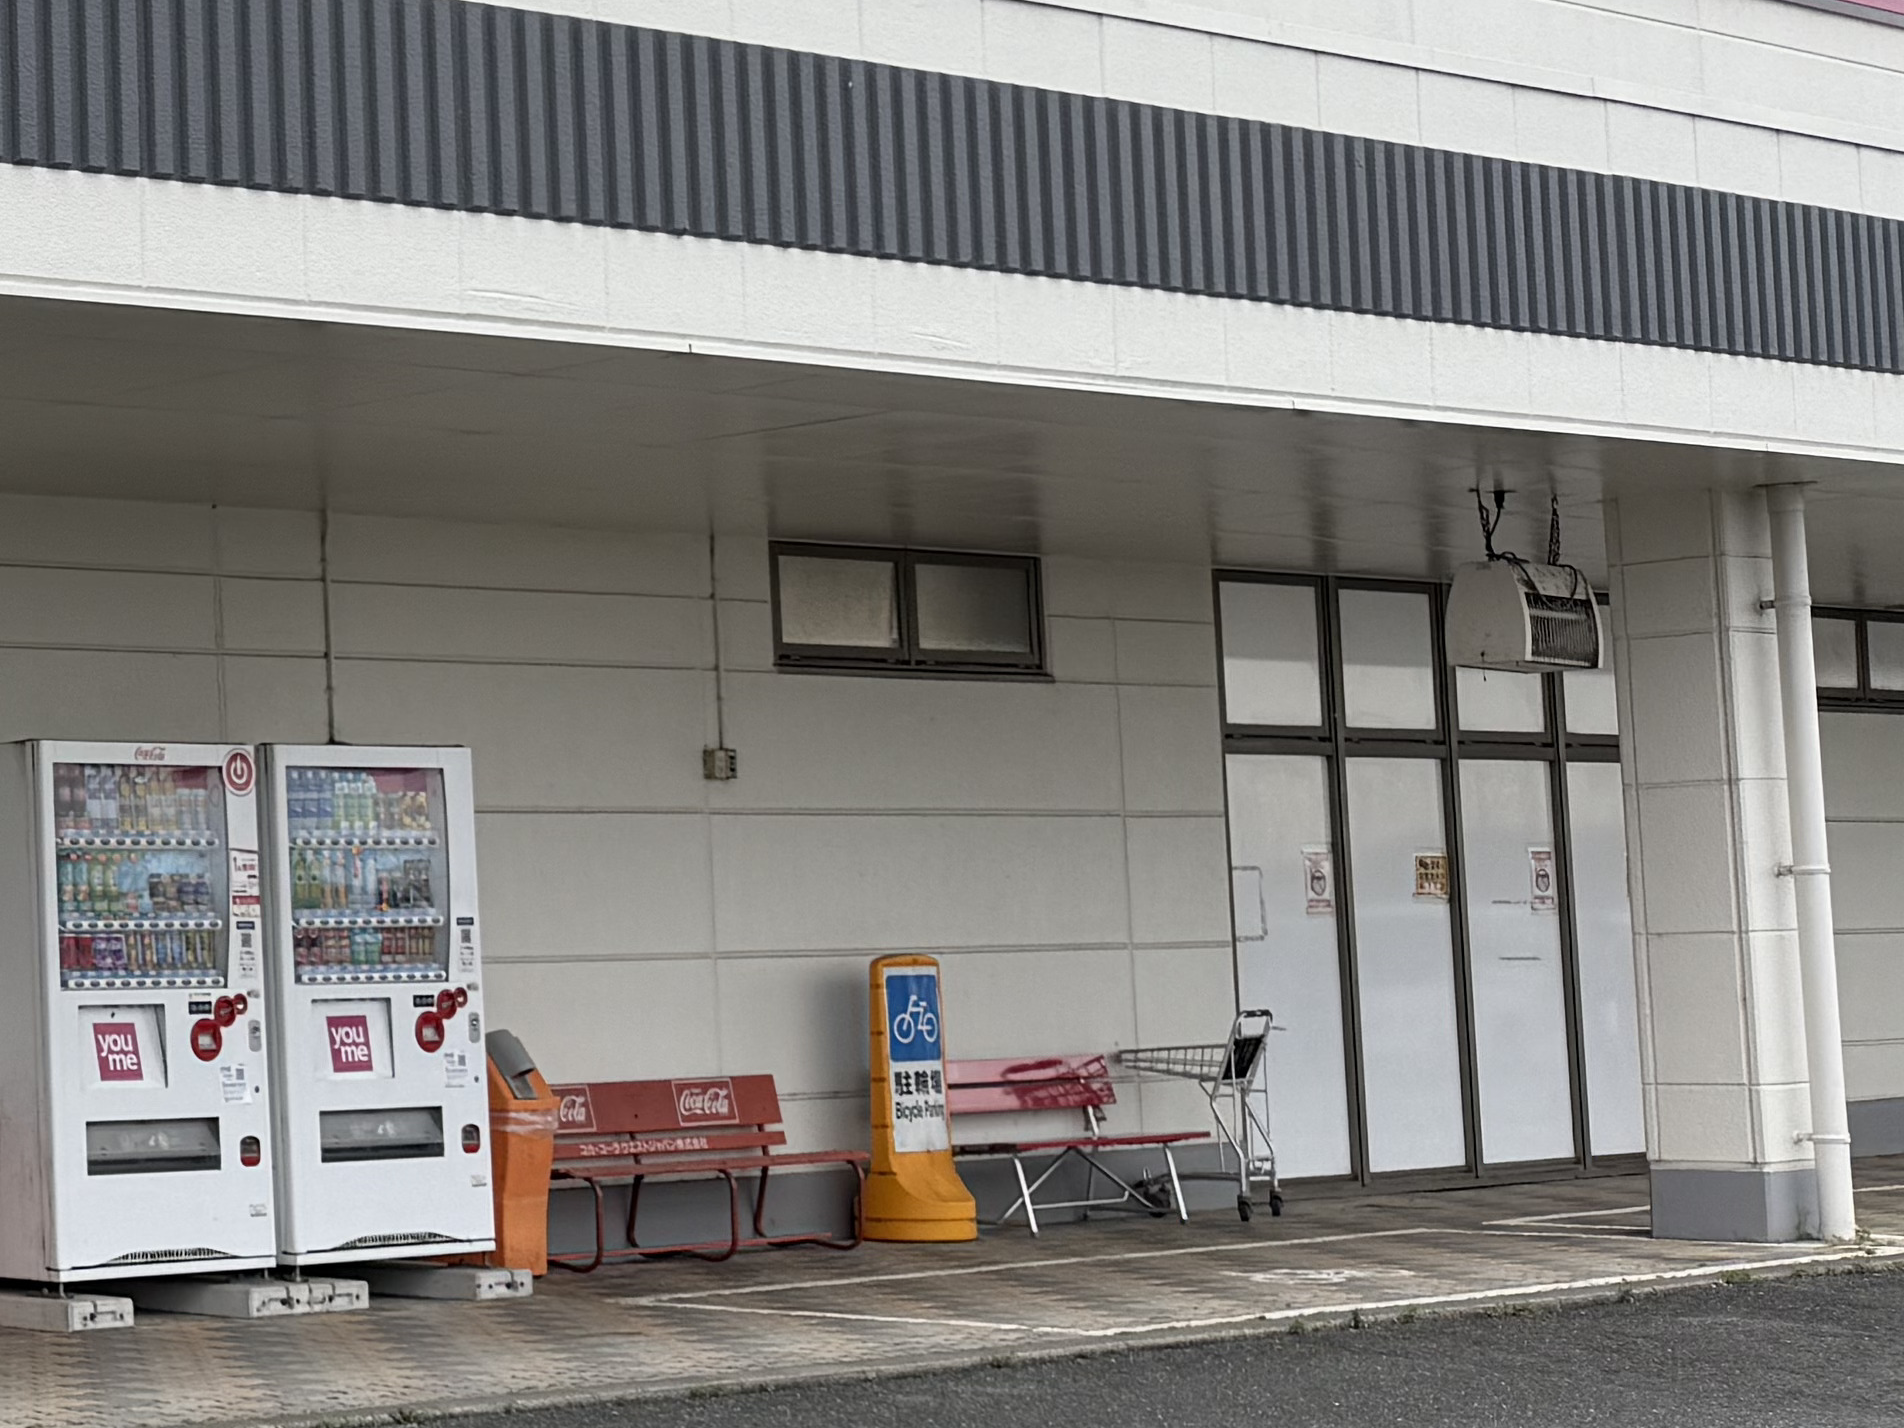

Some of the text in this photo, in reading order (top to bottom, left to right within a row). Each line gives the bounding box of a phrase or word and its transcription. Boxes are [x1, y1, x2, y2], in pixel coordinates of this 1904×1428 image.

[97, 1033, 133, 1057] you
[330, 1026, 365, 1049] you
[108, 1052, 138, 1071] me
[341, 1045, 369, 1063] me
[895, 1100, 923, 1122] Bicycle
